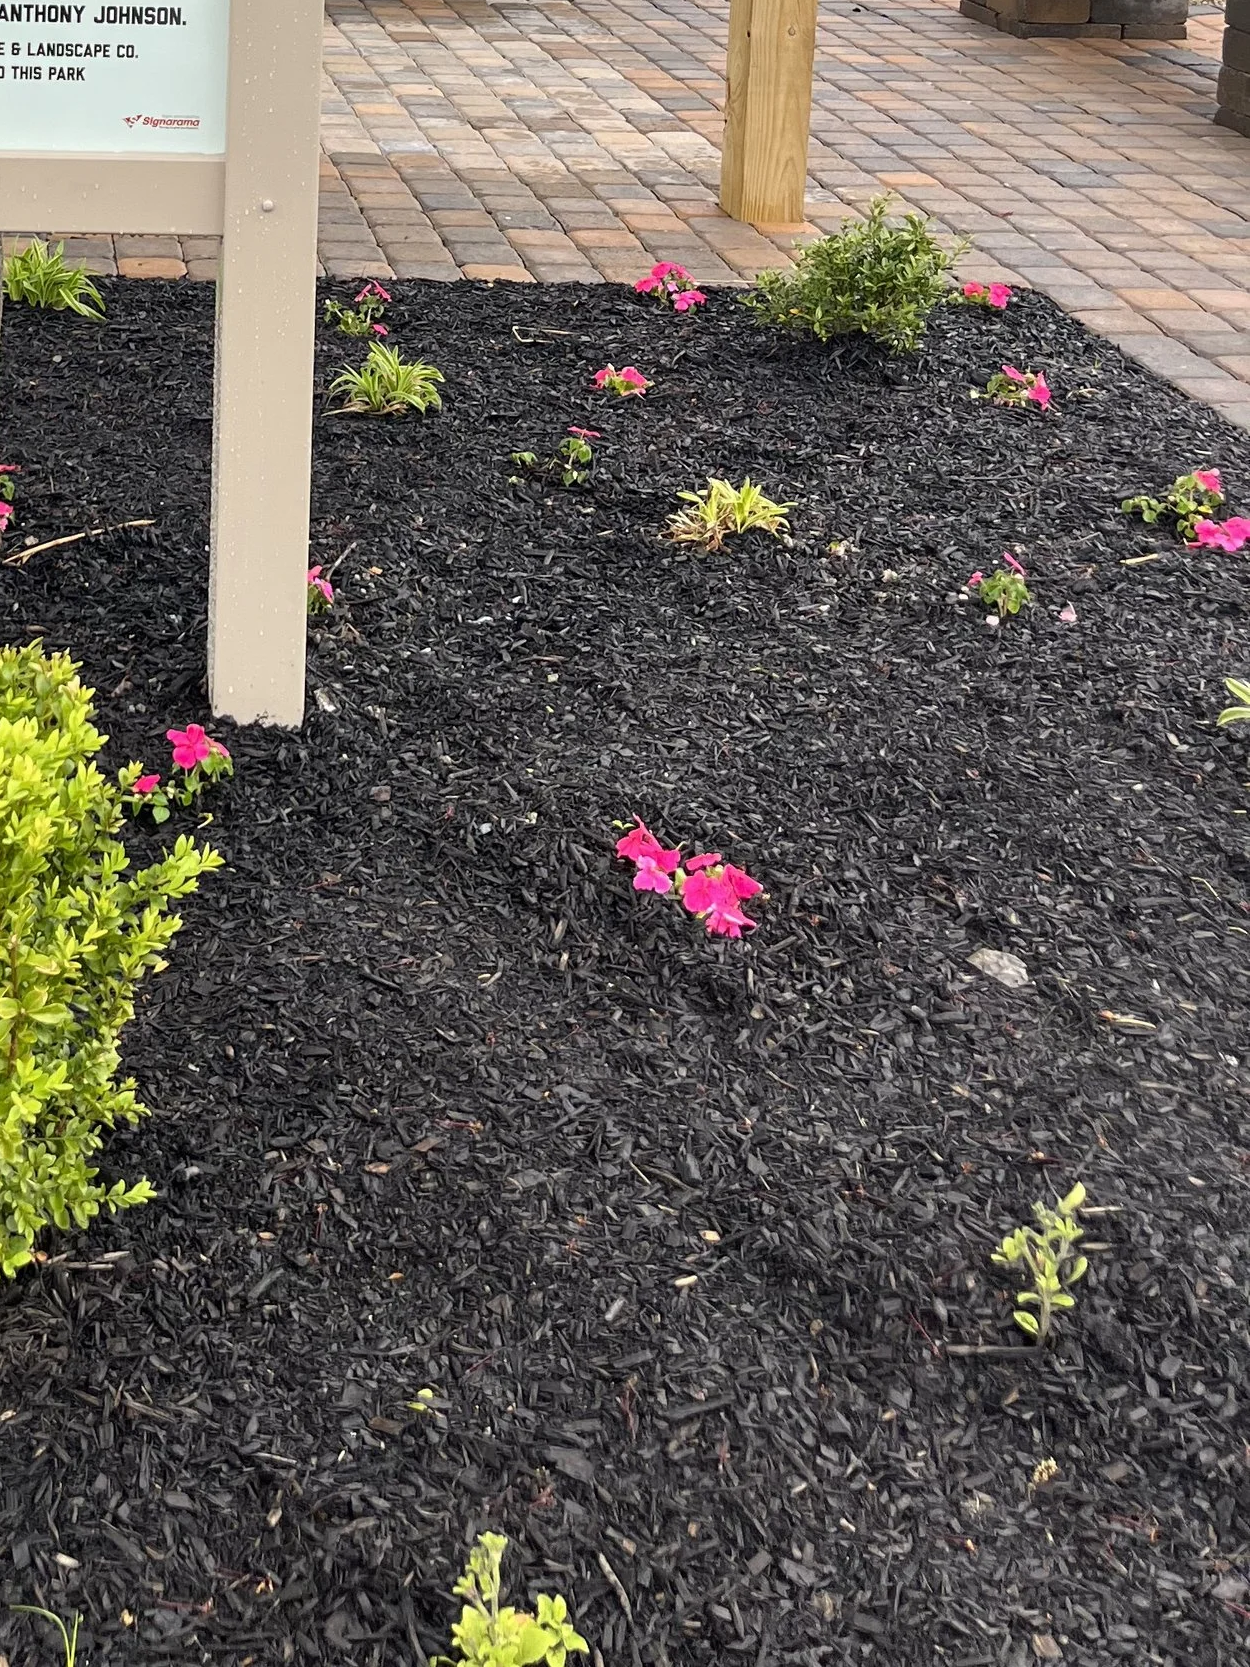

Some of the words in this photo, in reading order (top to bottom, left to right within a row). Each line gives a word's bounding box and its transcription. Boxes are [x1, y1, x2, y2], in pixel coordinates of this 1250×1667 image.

[93, 5, 187, 26] JOHNSON.
[10, 41, 22, 56] &
[27, 42, 111, 59] LANDSCAPE
[116, 44, 139, 59] CO.
[10, 65, 43, 81] THIS
[48, 66, 86, 82] PARK
[142, 115, 201, 128] Signarama
